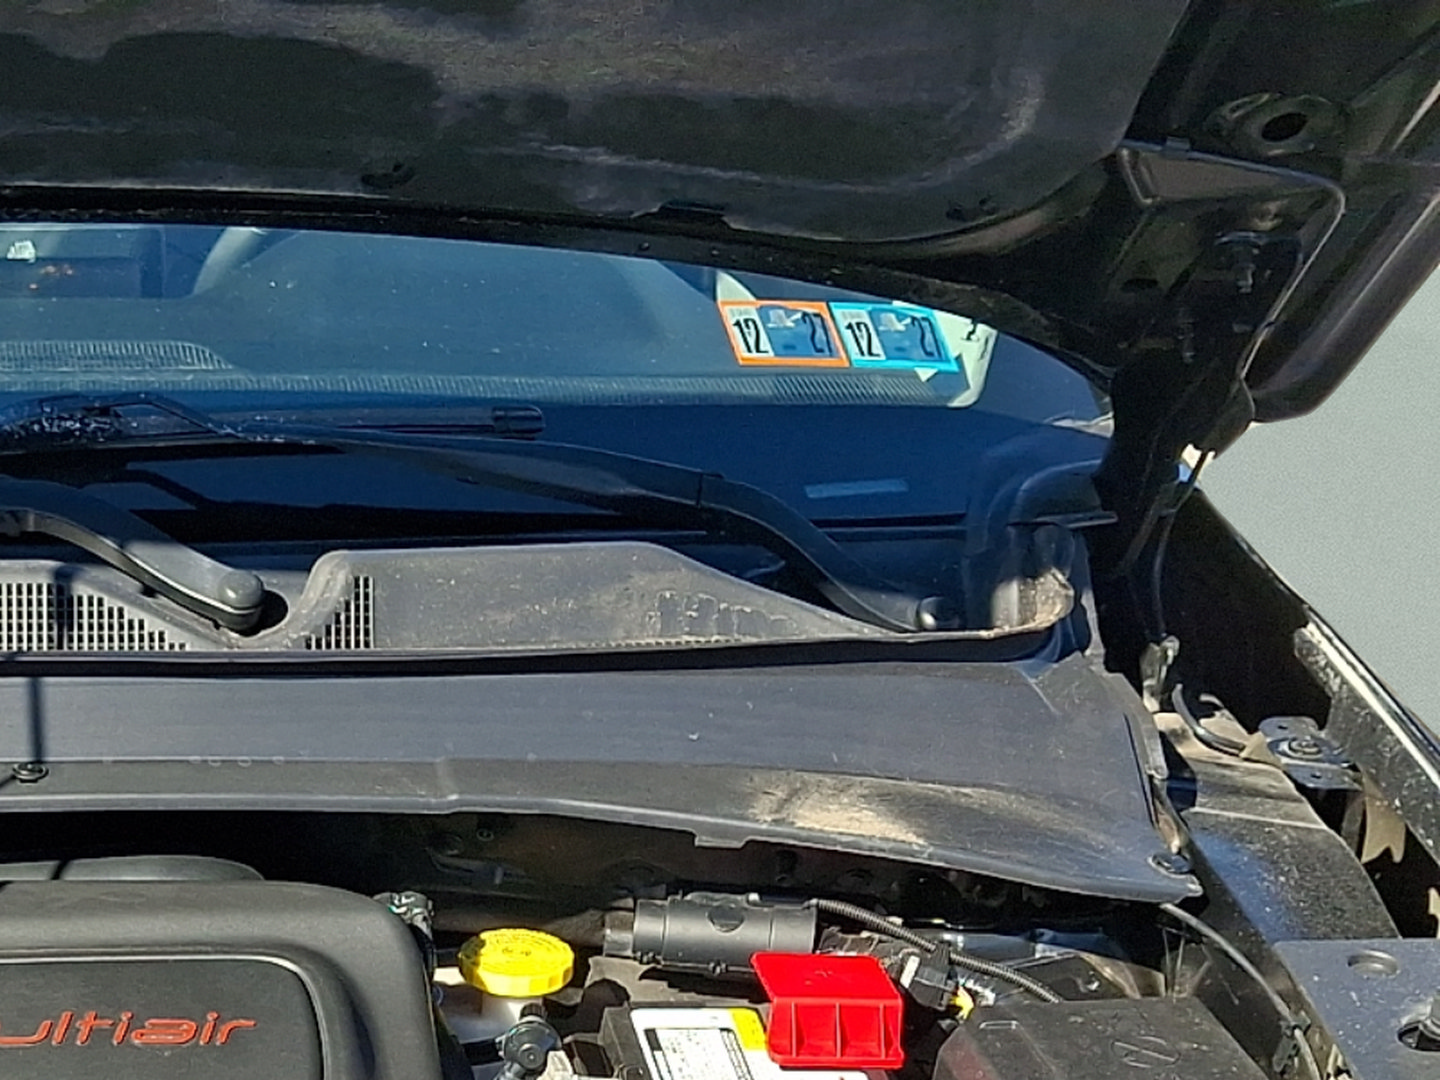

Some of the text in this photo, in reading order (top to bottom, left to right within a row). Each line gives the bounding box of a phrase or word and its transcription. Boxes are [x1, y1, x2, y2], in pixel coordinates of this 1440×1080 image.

[732, 312, 833, 357] 12 27
[844, 322, 880, 357] 12
[910, 316, 943, 359] 27
